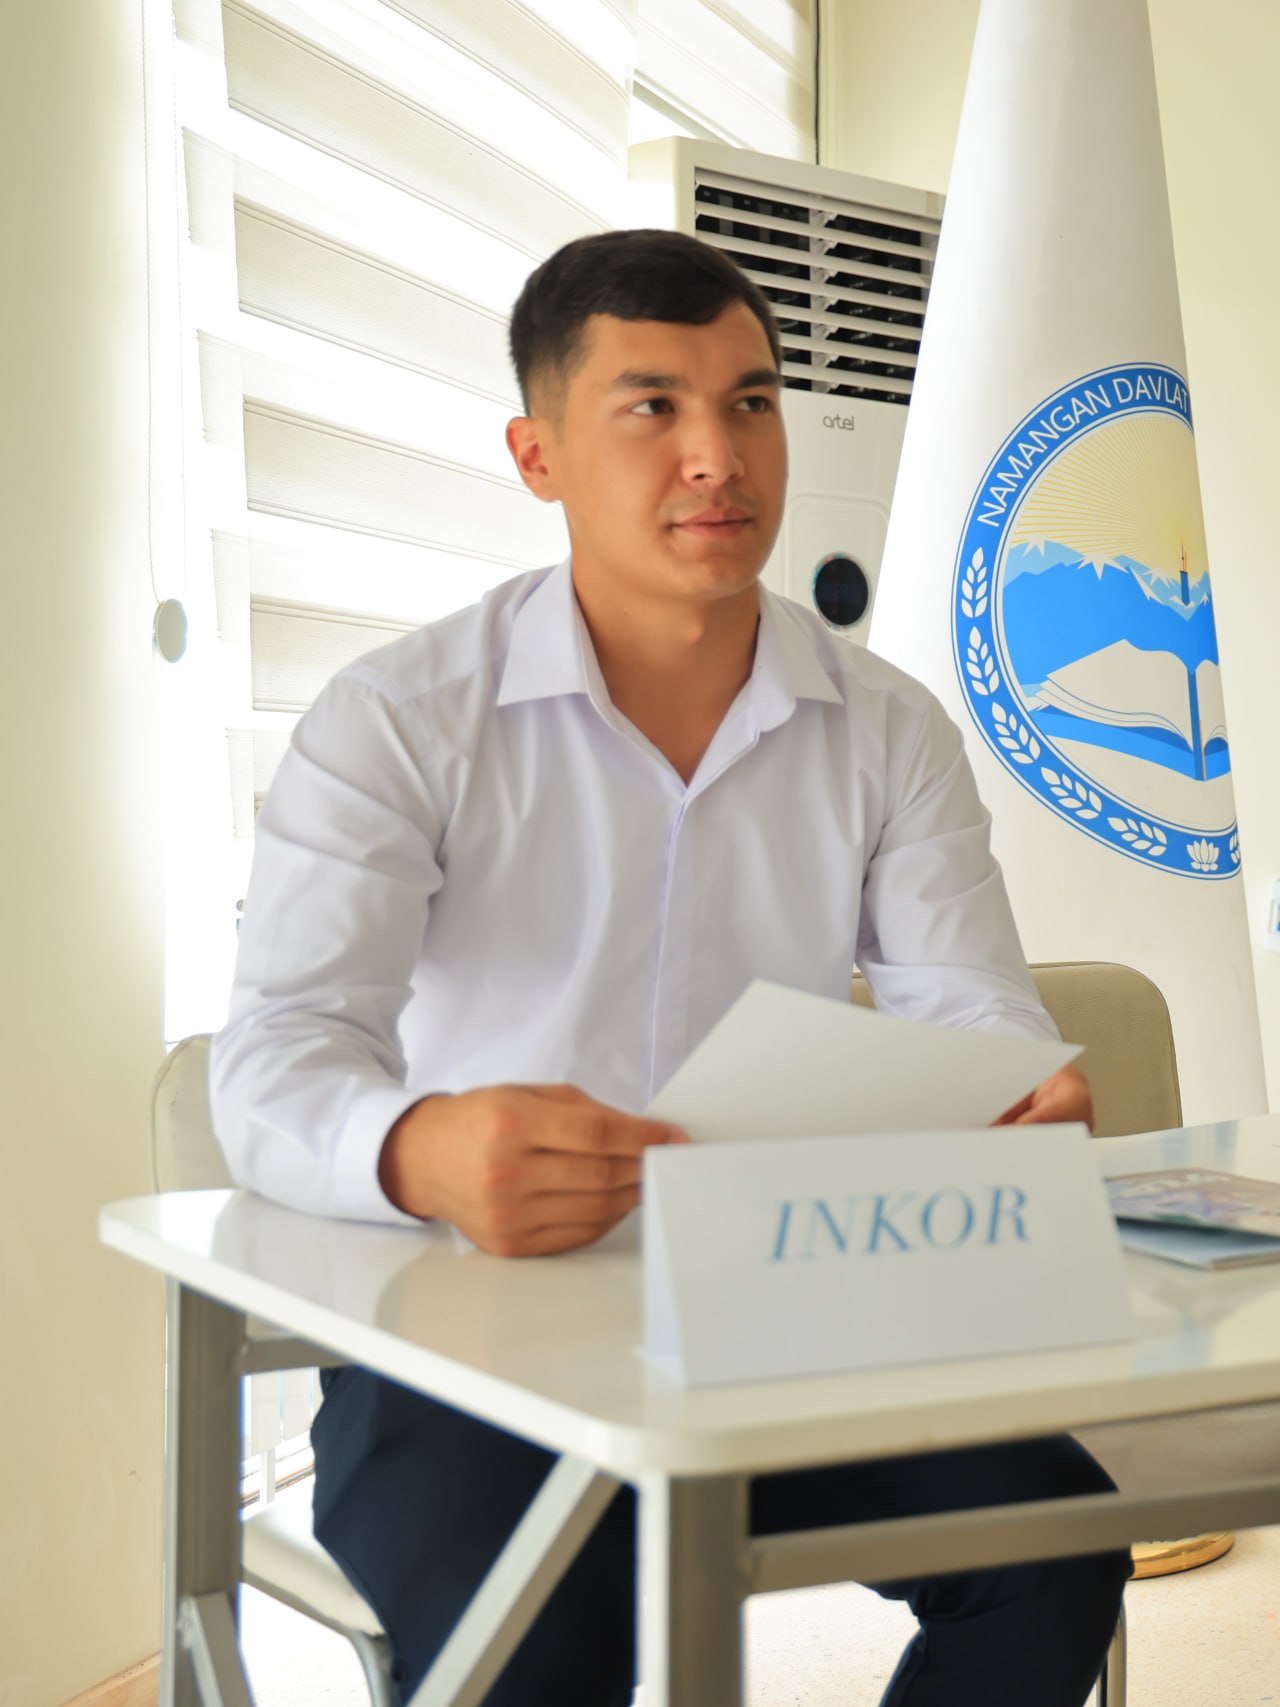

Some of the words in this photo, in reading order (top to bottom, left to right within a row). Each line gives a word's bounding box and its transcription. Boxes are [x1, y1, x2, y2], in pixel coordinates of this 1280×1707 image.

[822, 413, 855, 431] artel
[976, 384, 1112, 527] NAMANGAN
[1112, 374, 1188, 414] DAVLAT
[765, 1183, 1031, 1264] INKOR
